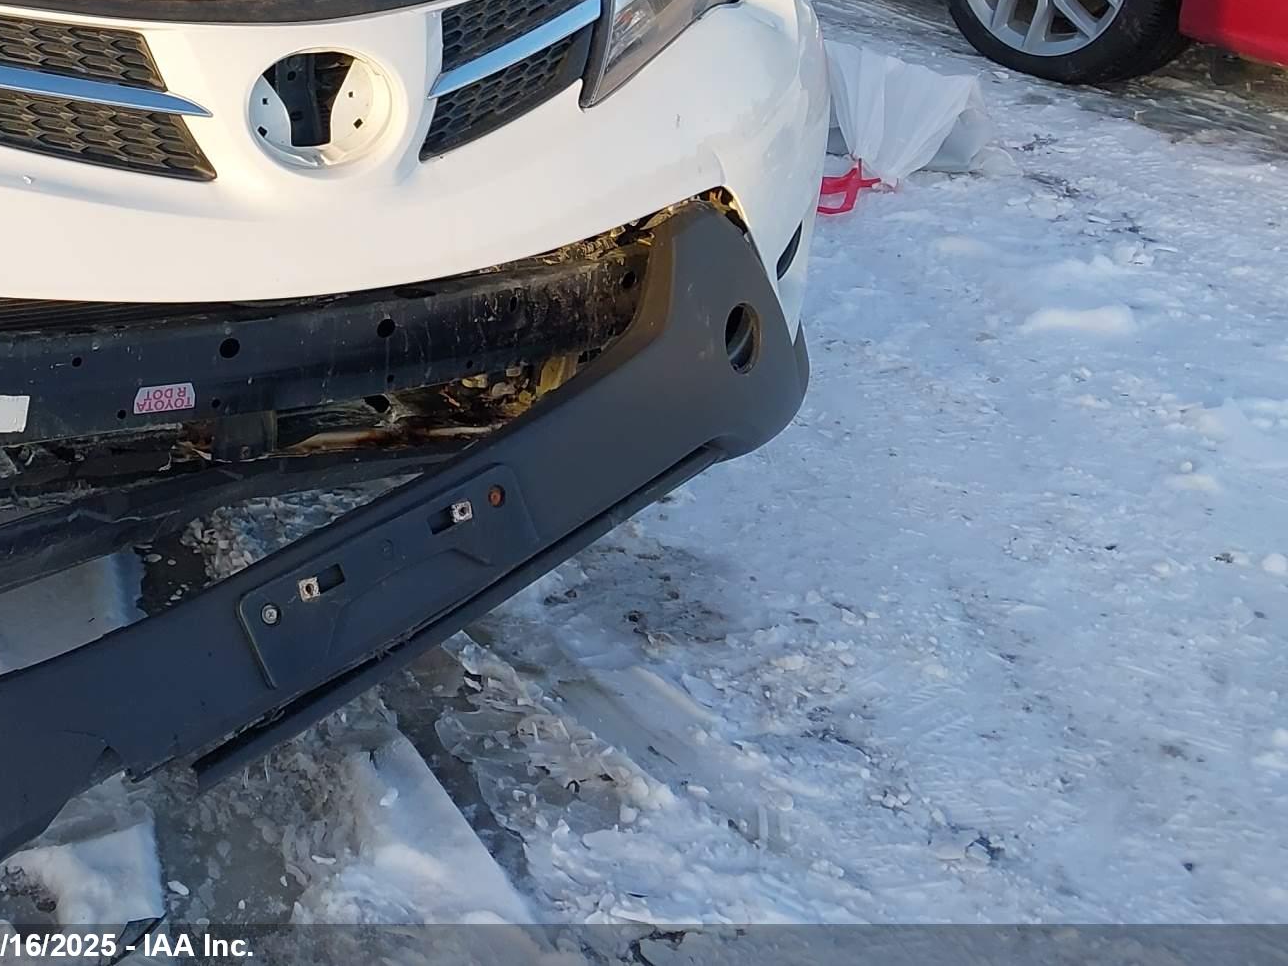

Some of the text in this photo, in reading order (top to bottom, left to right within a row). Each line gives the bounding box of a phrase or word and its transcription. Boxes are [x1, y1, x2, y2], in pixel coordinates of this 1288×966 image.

[143, 387, 187, 401] R DOT
[136, 397, 192, 412] TOYOTA
